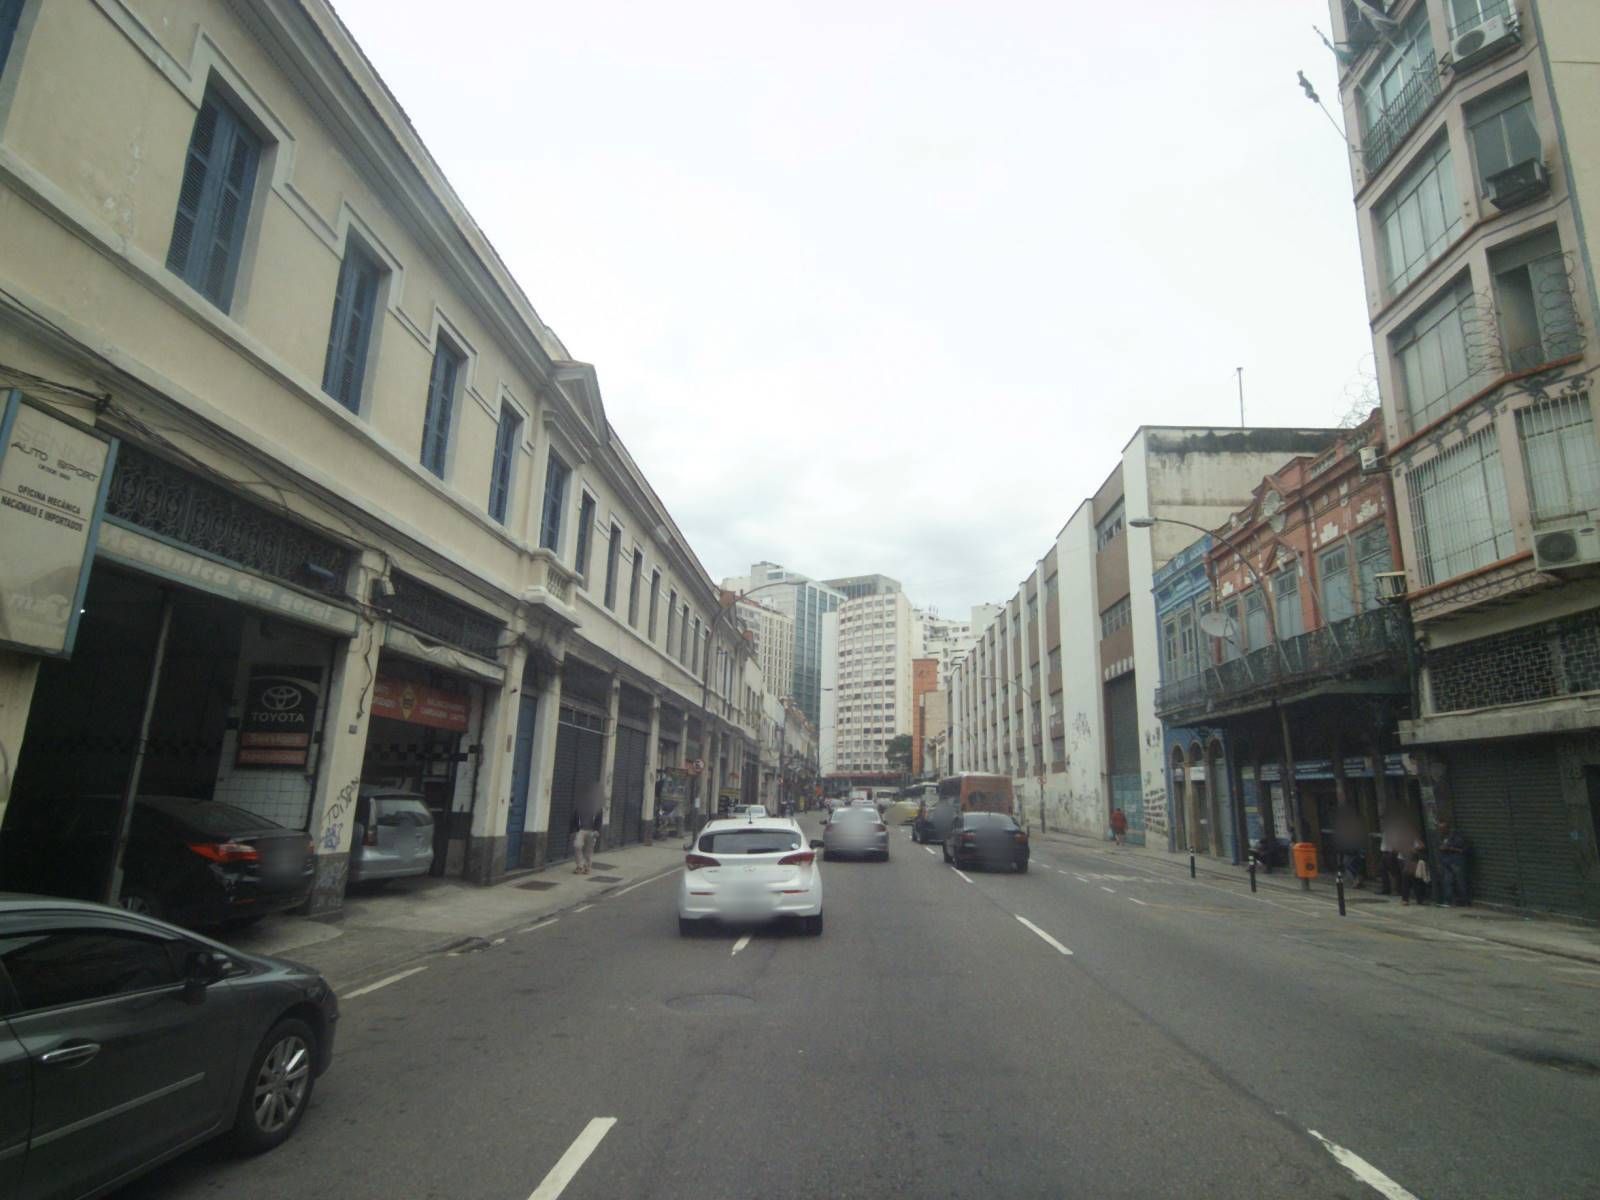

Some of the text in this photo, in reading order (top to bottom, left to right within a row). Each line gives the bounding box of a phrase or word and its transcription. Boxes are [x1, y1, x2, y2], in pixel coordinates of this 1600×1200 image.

[11, 442, 99, 482] AUTO SPORT
[18, 484, 46, 501] OFICINA
[1, 496, 83, 532] NACIONAIS E IMPORTADOS
[236, 578, 273, 599] em
[250, 711, 305, 723] TOYOTA
